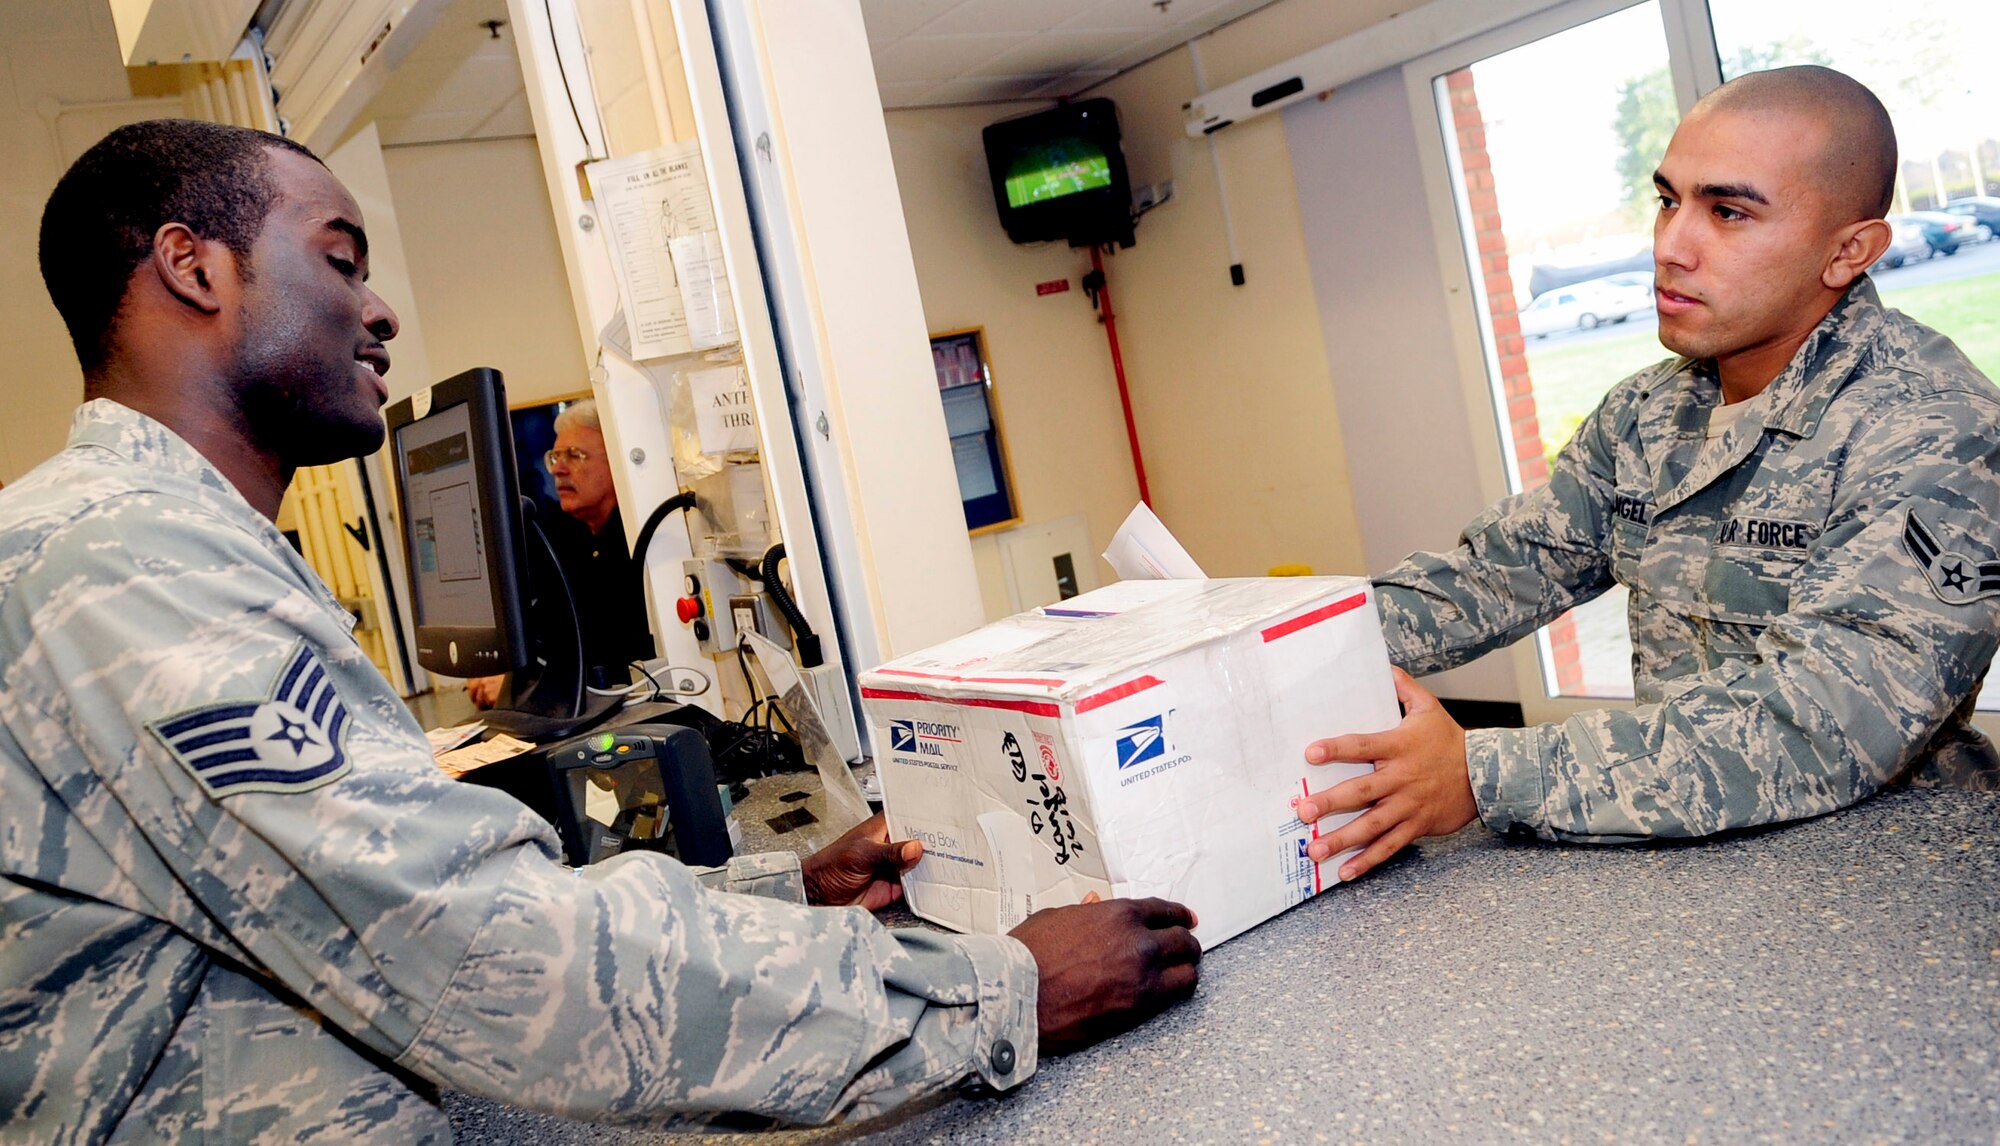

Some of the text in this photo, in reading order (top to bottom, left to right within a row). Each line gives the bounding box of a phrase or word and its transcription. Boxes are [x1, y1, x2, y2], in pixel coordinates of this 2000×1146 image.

[722, 412, 754, 428] THR
[1747, 520, 1808, 549] FORCE
[917, 722, 957, 738] PRIORITY
[919, 742, 944, 756] MAIL
[893, 757, 909, 765] UNITED
[909, 759, 924, 767] STATES
[1121, 771, 1150, 787] UNITED
[1151, 761, 1177, 775] STATES
[937, 831, 957, 849] Box
